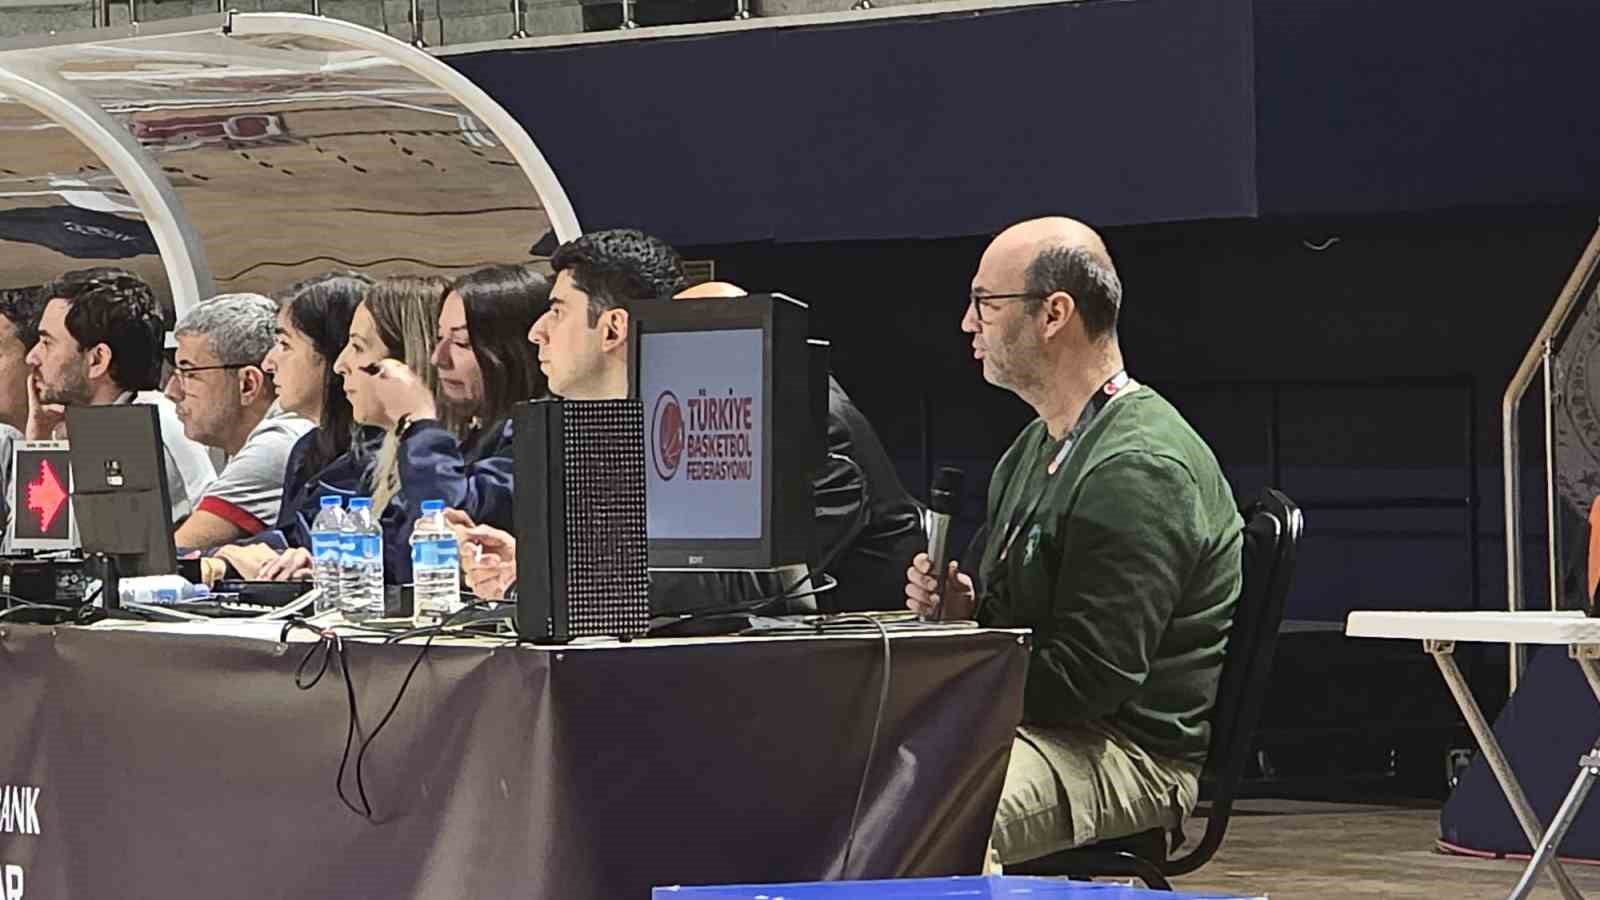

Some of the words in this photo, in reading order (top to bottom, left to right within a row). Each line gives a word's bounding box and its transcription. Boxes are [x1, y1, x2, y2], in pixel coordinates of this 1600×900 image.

[687, 388, 752, 431] TÜRKİYE
[687, 433, 752, 458] BASKETBOL
[687, 460, 752, 480] FEDERASYONU
[0, 785, 40, 834] ANK
